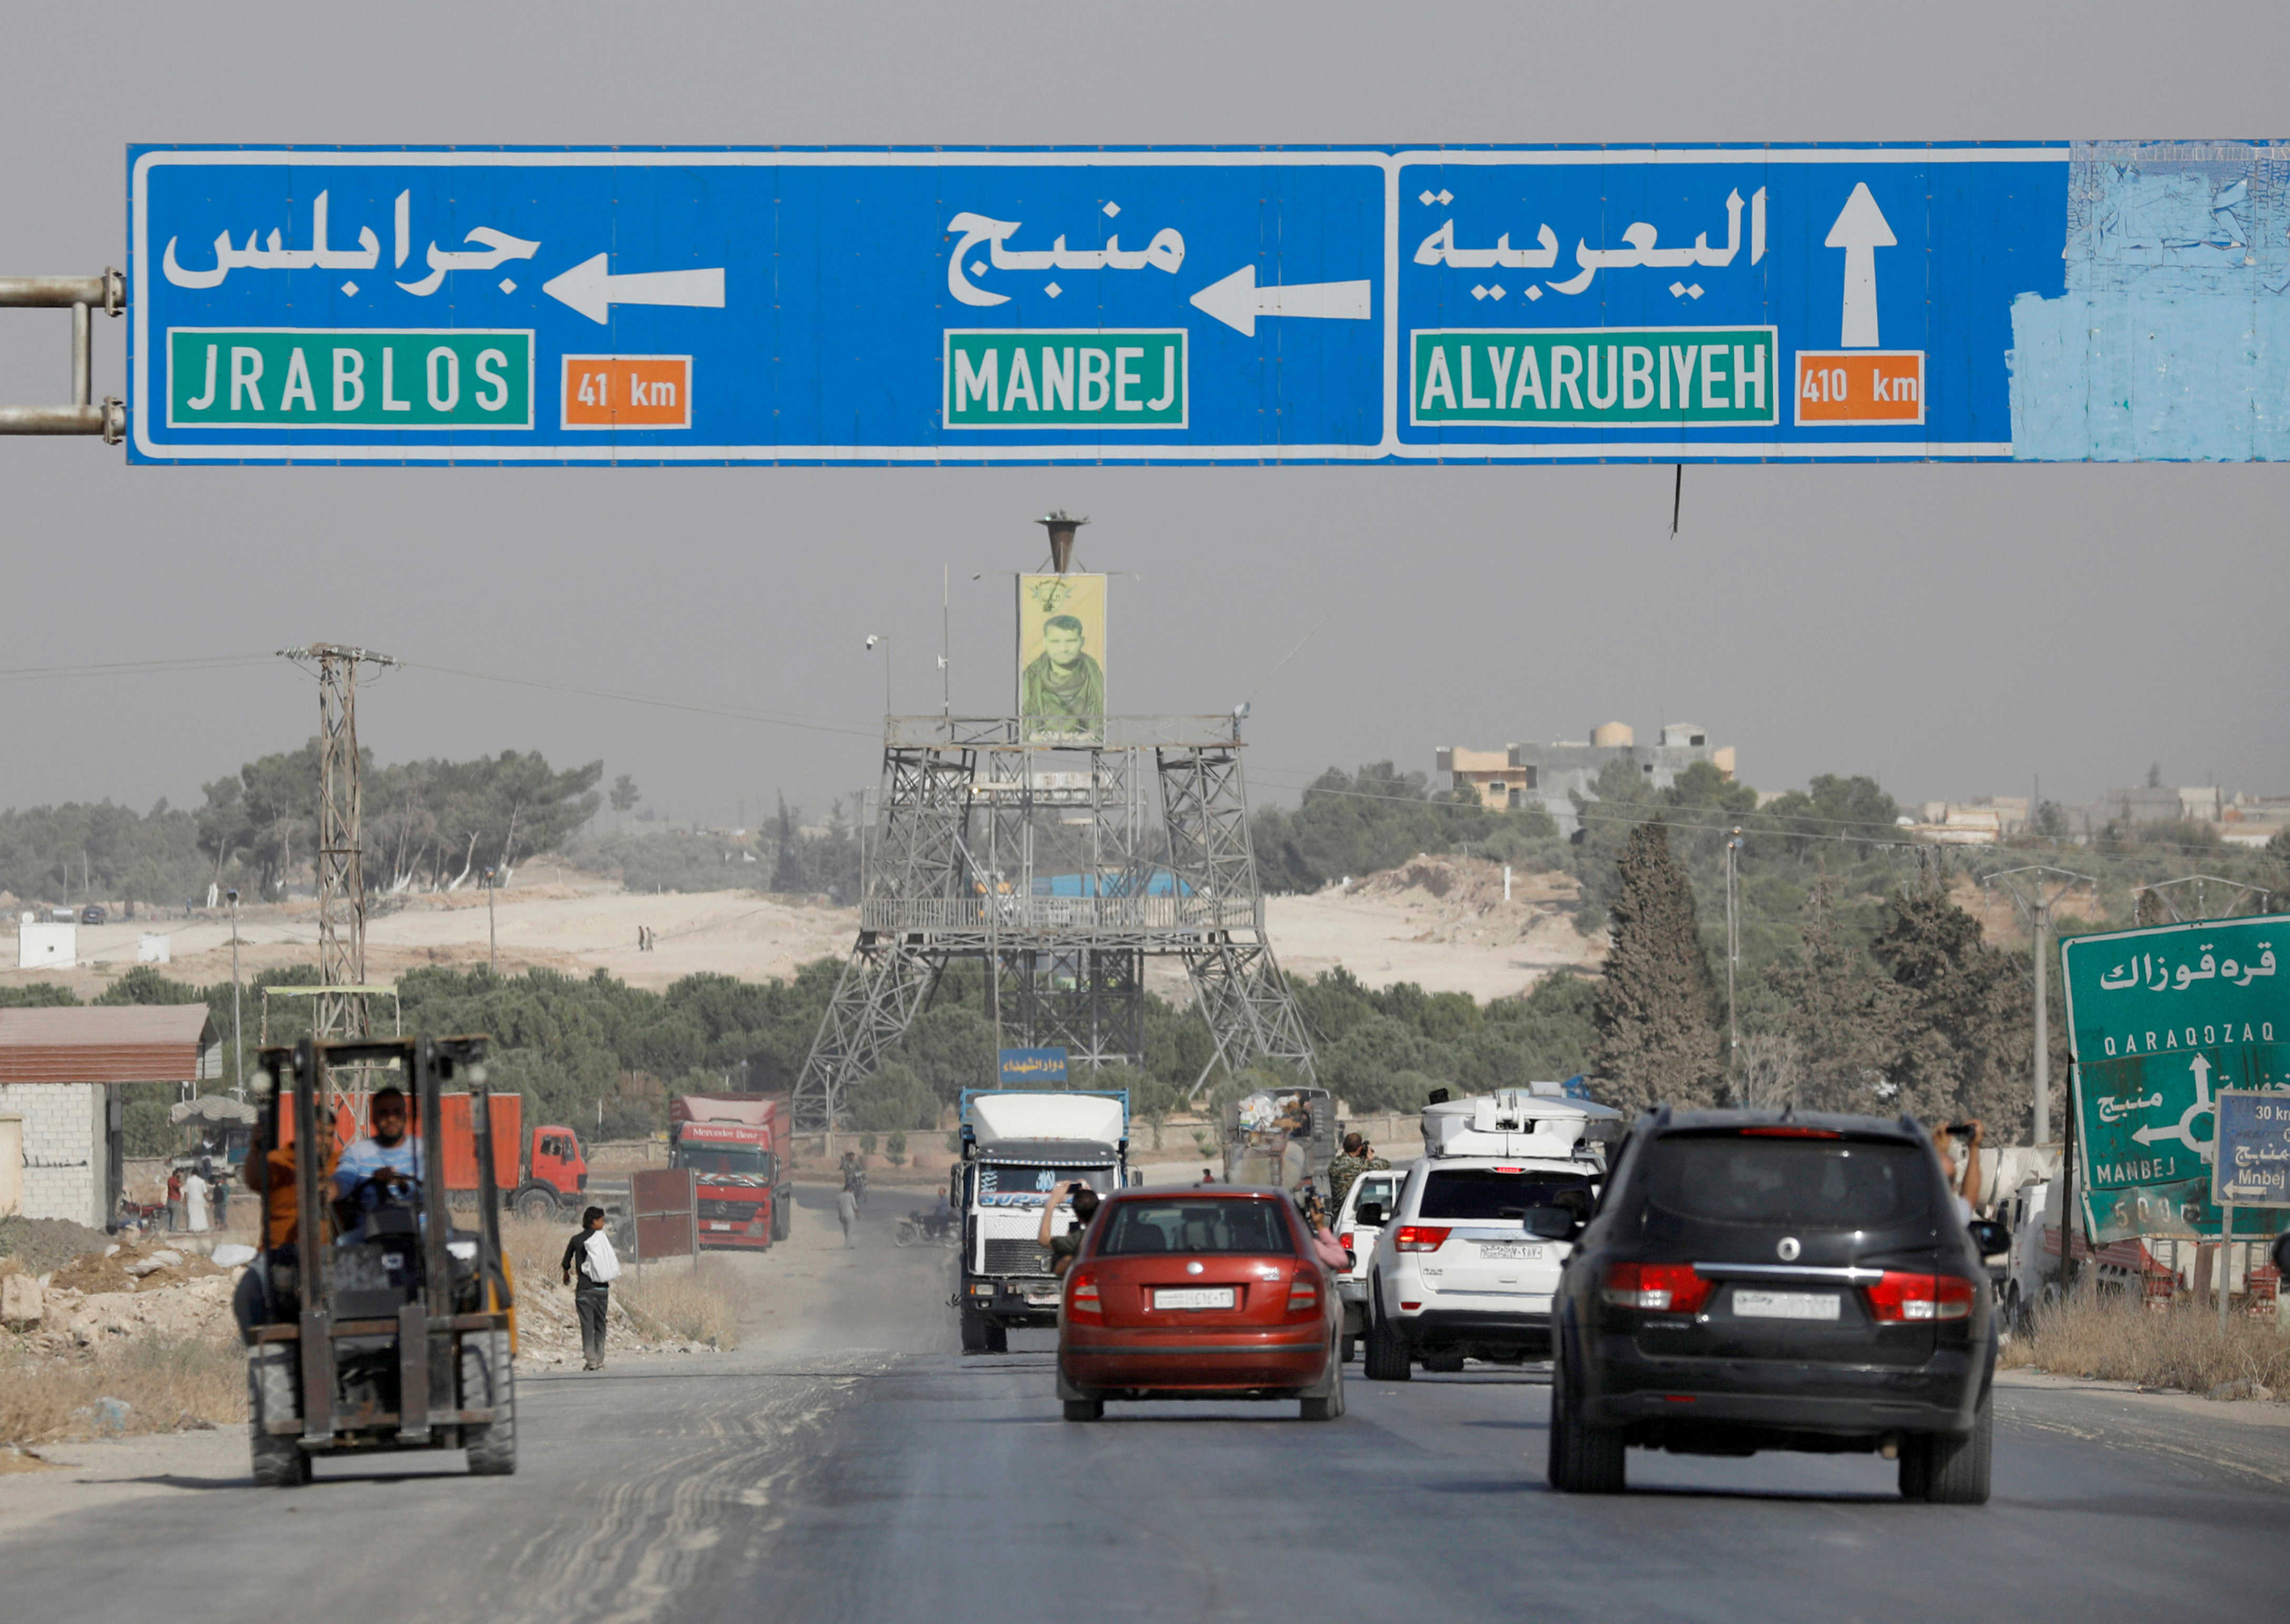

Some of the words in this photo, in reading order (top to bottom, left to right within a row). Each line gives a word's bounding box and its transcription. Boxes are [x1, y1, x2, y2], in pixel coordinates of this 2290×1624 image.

[162, 188, 543, 297] جرابلس
[947, 200, 1185, 307] منبج
[1413, 185, 1766, 302] اليعربية
[186, 343, 509, 412] JRABLOS
[577, 375, 608, 407] 41
[631, 374, 677, 407] km
[954, 345, 1176, 412] MANBEJ
[1421, 344, 1765, 410] ALYARUBIYEH
[1802, 367, 1848, 403] 410
[1873, 366, 1918, 403] km
[2100, 943, 2216, 991] قوزاك
[2221, 942, 2276, 986] قره
[2105, 1022, 2274, 1056] QARAQOZAQ
[2097, 1086, 2163, 1123] منبج
[2255, 1105, 2272, 1120] 30
[692, 1127, 733, 1137] Mercedes
[2096, 1156, 2175, 1184] MANBEJ
[2235, 1143, 2290, 1167] منبج
[2238, 1168, 2285, 1189] Mnbej
